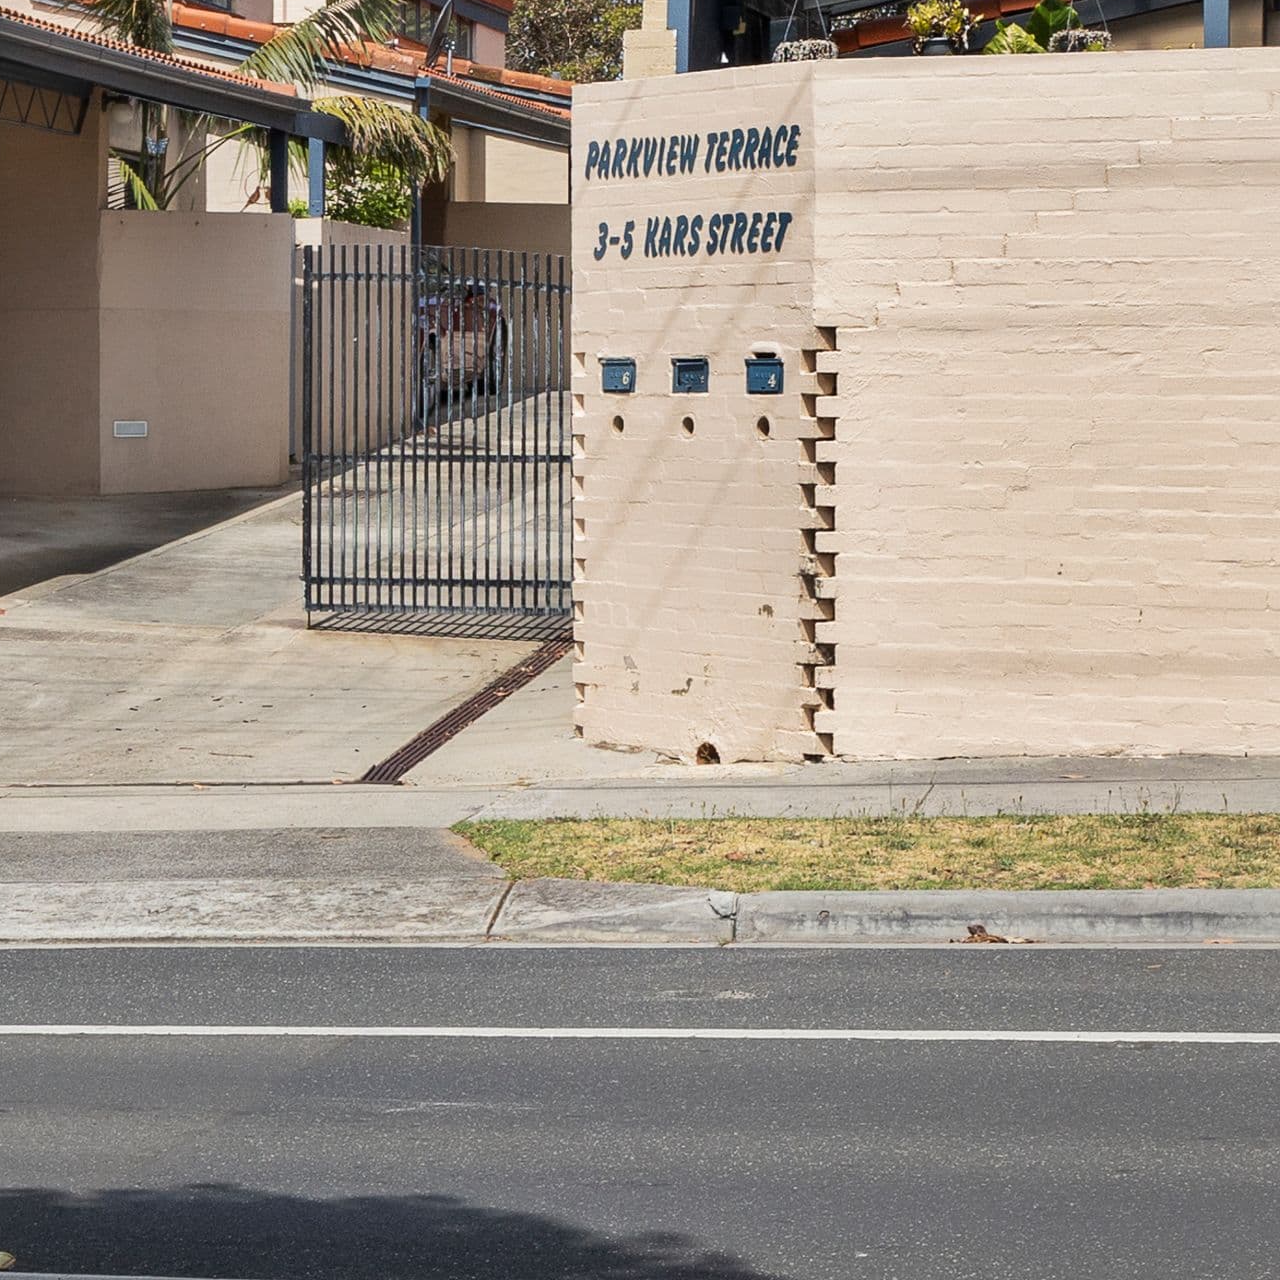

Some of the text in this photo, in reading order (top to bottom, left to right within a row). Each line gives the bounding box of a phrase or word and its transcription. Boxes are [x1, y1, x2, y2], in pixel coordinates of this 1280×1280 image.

[585, 124, 802, 181] PARKVIEW TERRACE
[593, 211, 793, 261] 3-5 KARS STREET
[622, 371, 630, 385] 6
[767, 373, 776, 388] 4
